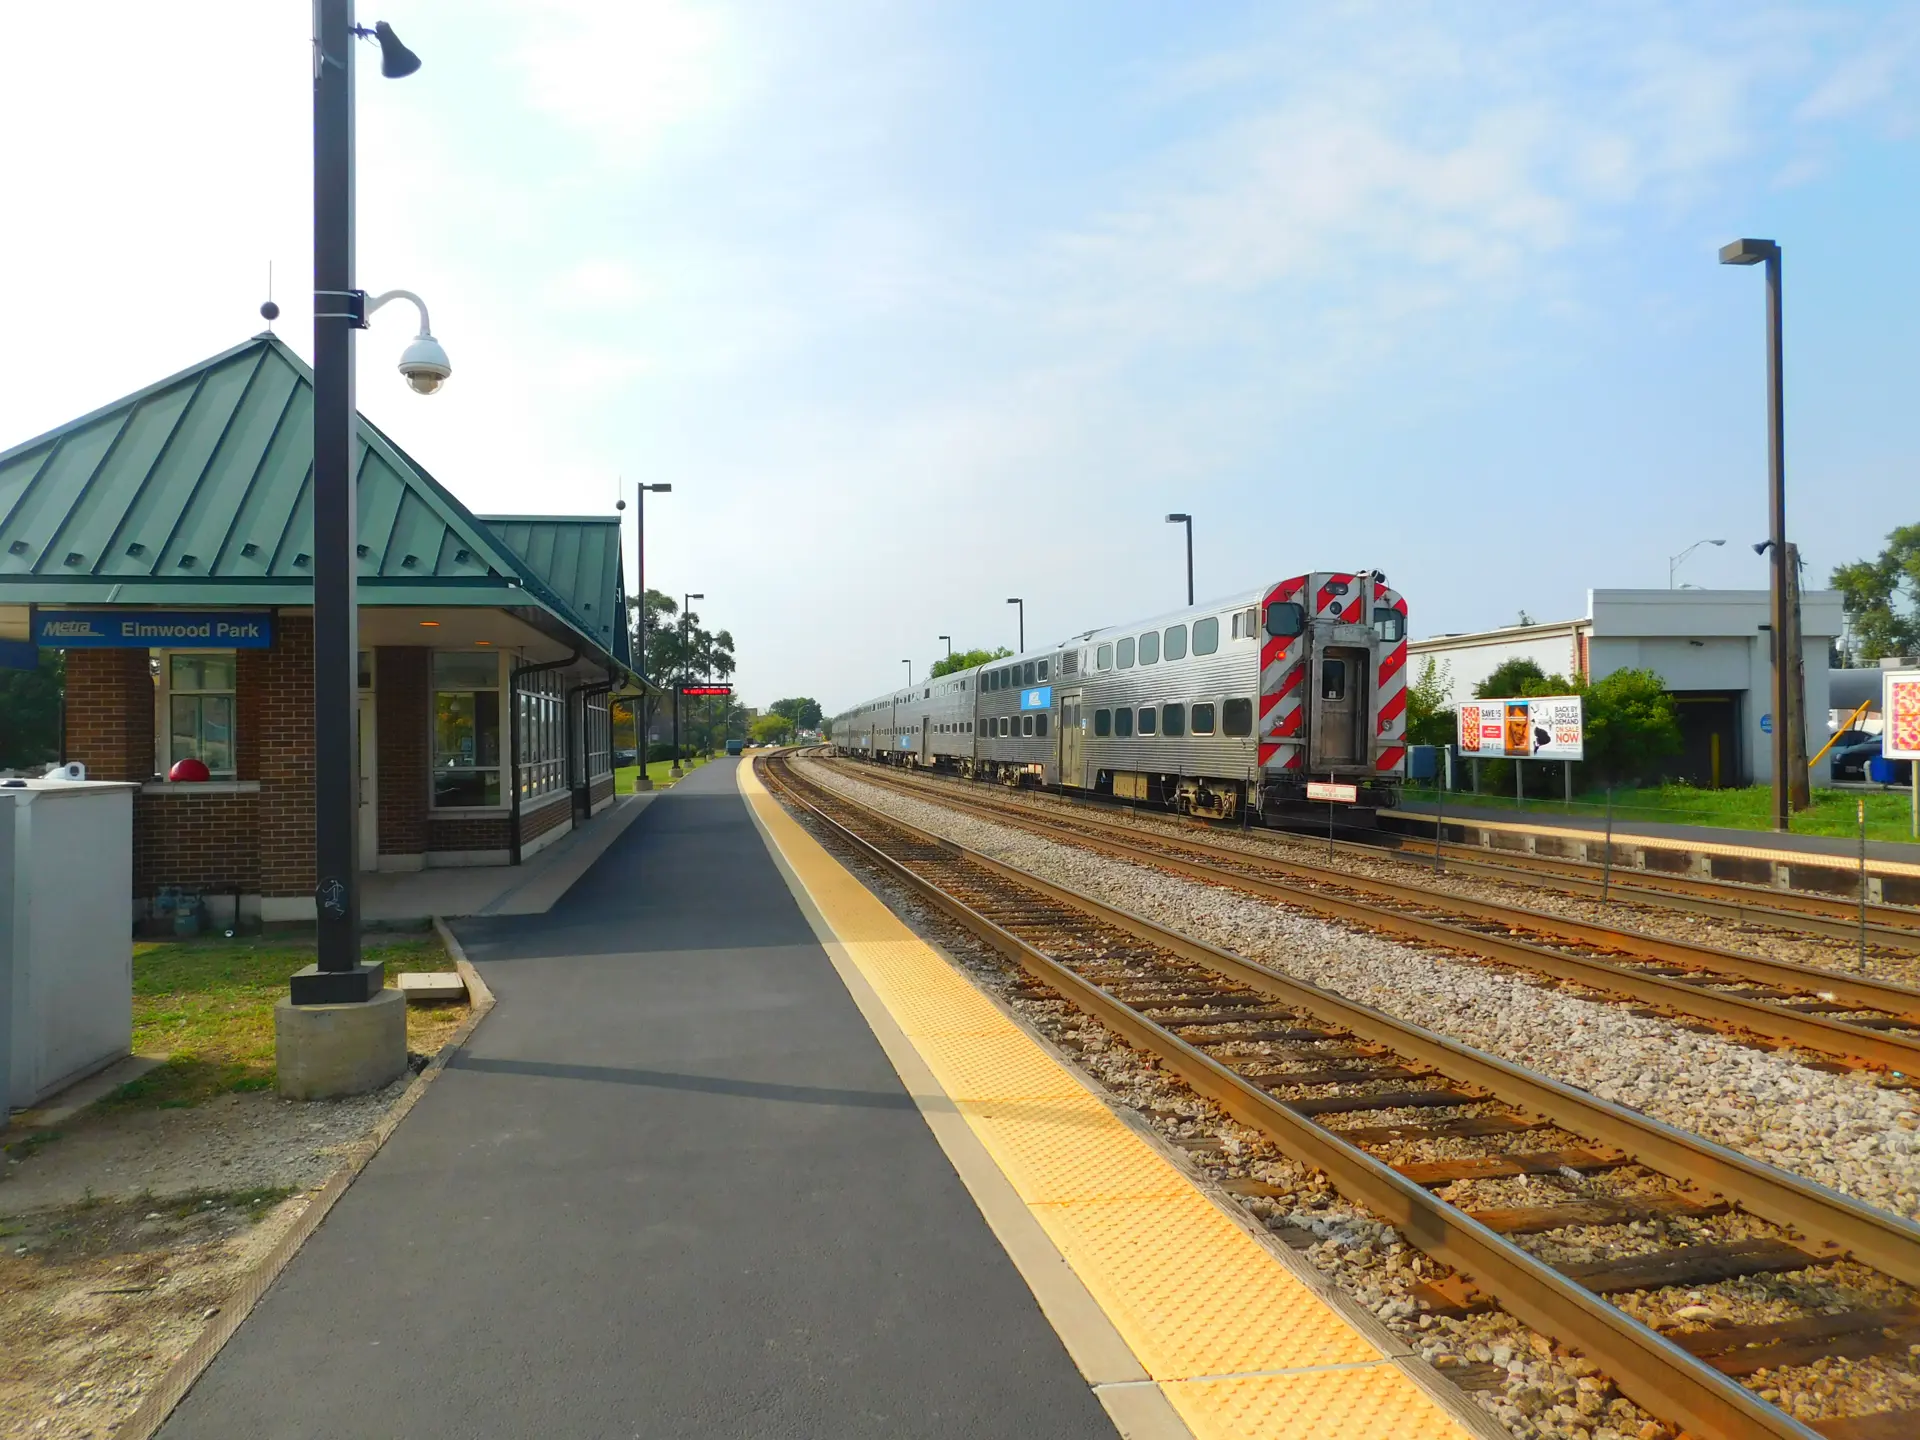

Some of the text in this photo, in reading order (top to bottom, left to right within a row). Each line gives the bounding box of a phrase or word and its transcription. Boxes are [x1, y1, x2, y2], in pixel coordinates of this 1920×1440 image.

[42, 621, 259, 637] Metra Elmwood Park
[1481, 709, 1495, 717] SAVE
[1555, 733, 1580, 743] NOW
